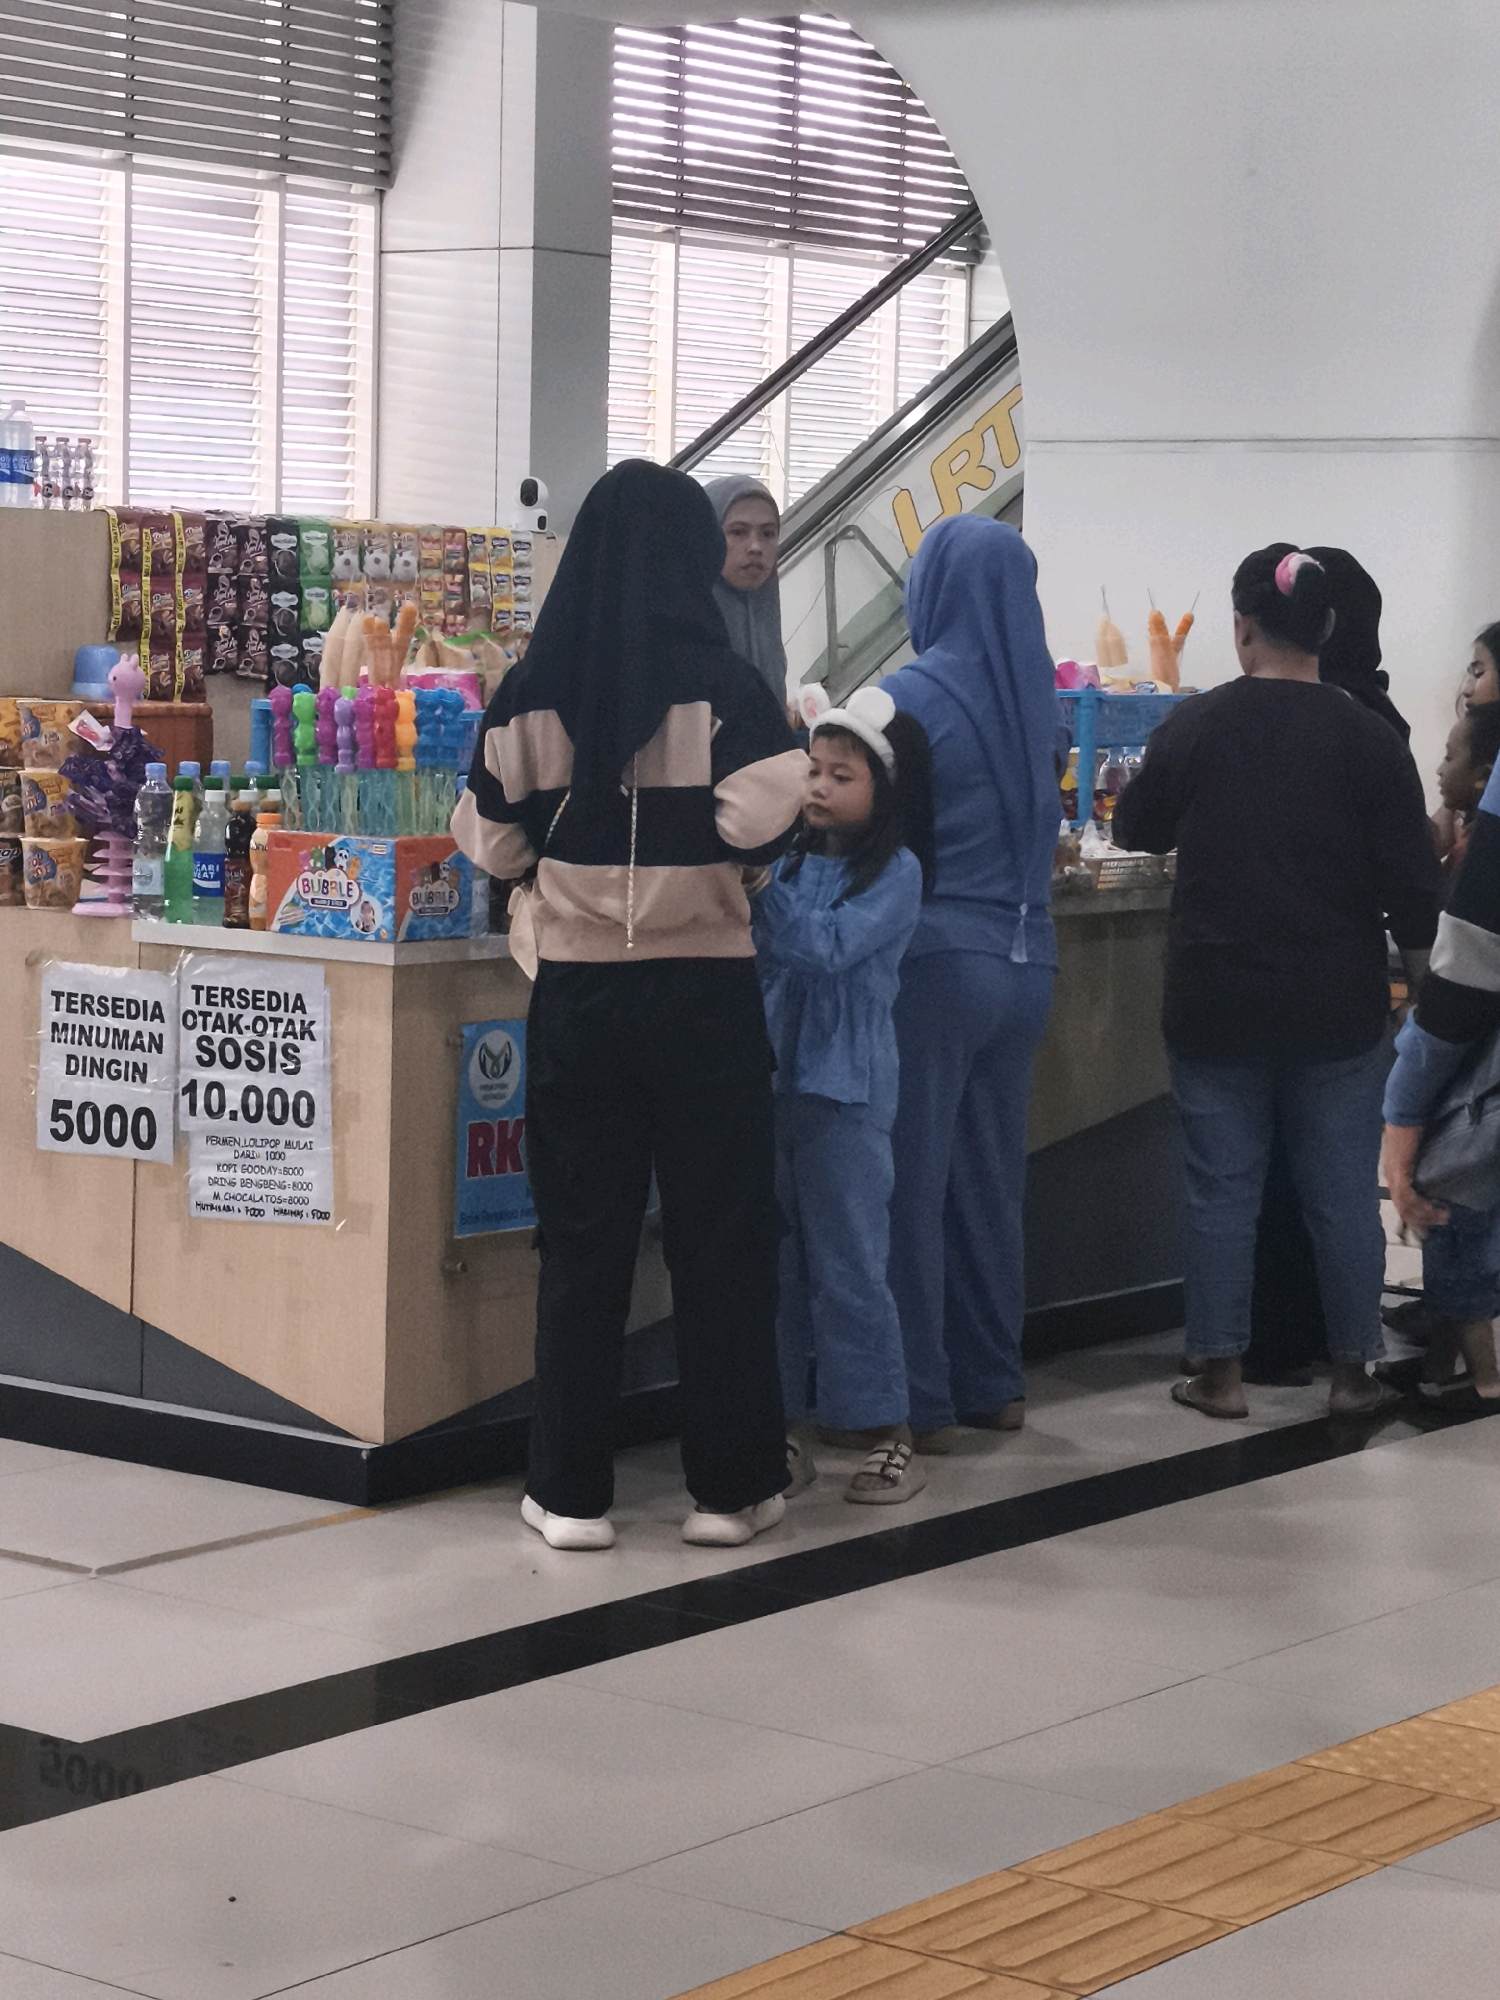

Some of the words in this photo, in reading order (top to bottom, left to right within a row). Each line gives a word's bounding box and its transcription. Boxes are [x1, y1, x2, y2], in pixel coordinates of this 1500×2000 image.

[892, 383, 1023, 558] LRT
[301, 877, 354, 898] BUBBLE
[412, 889, 455, 905] BUBBLE
[51, 990, 165, 1023] TERSEDIA
[191, 985, 307, 1014] TERSEDIA
[51, 1022, 163, 1054] MINUMAN
[182, 1009, 316, 1041] OTAK-OTAK
[65, 1054, 148, 1084] DINGIN
[195, 1035, 302, 1075] SOSIS
[182, 1079, 315, 1128] 10.000
[50, 1099, 157, 1151] 5000
[205, 1135, 241, 1147] PERMEN
[284, 1139, 313, 1150] MULAI
[265, 1150, 286, 1161] 1000
[216, 1162, 237, 1173] KOPI
